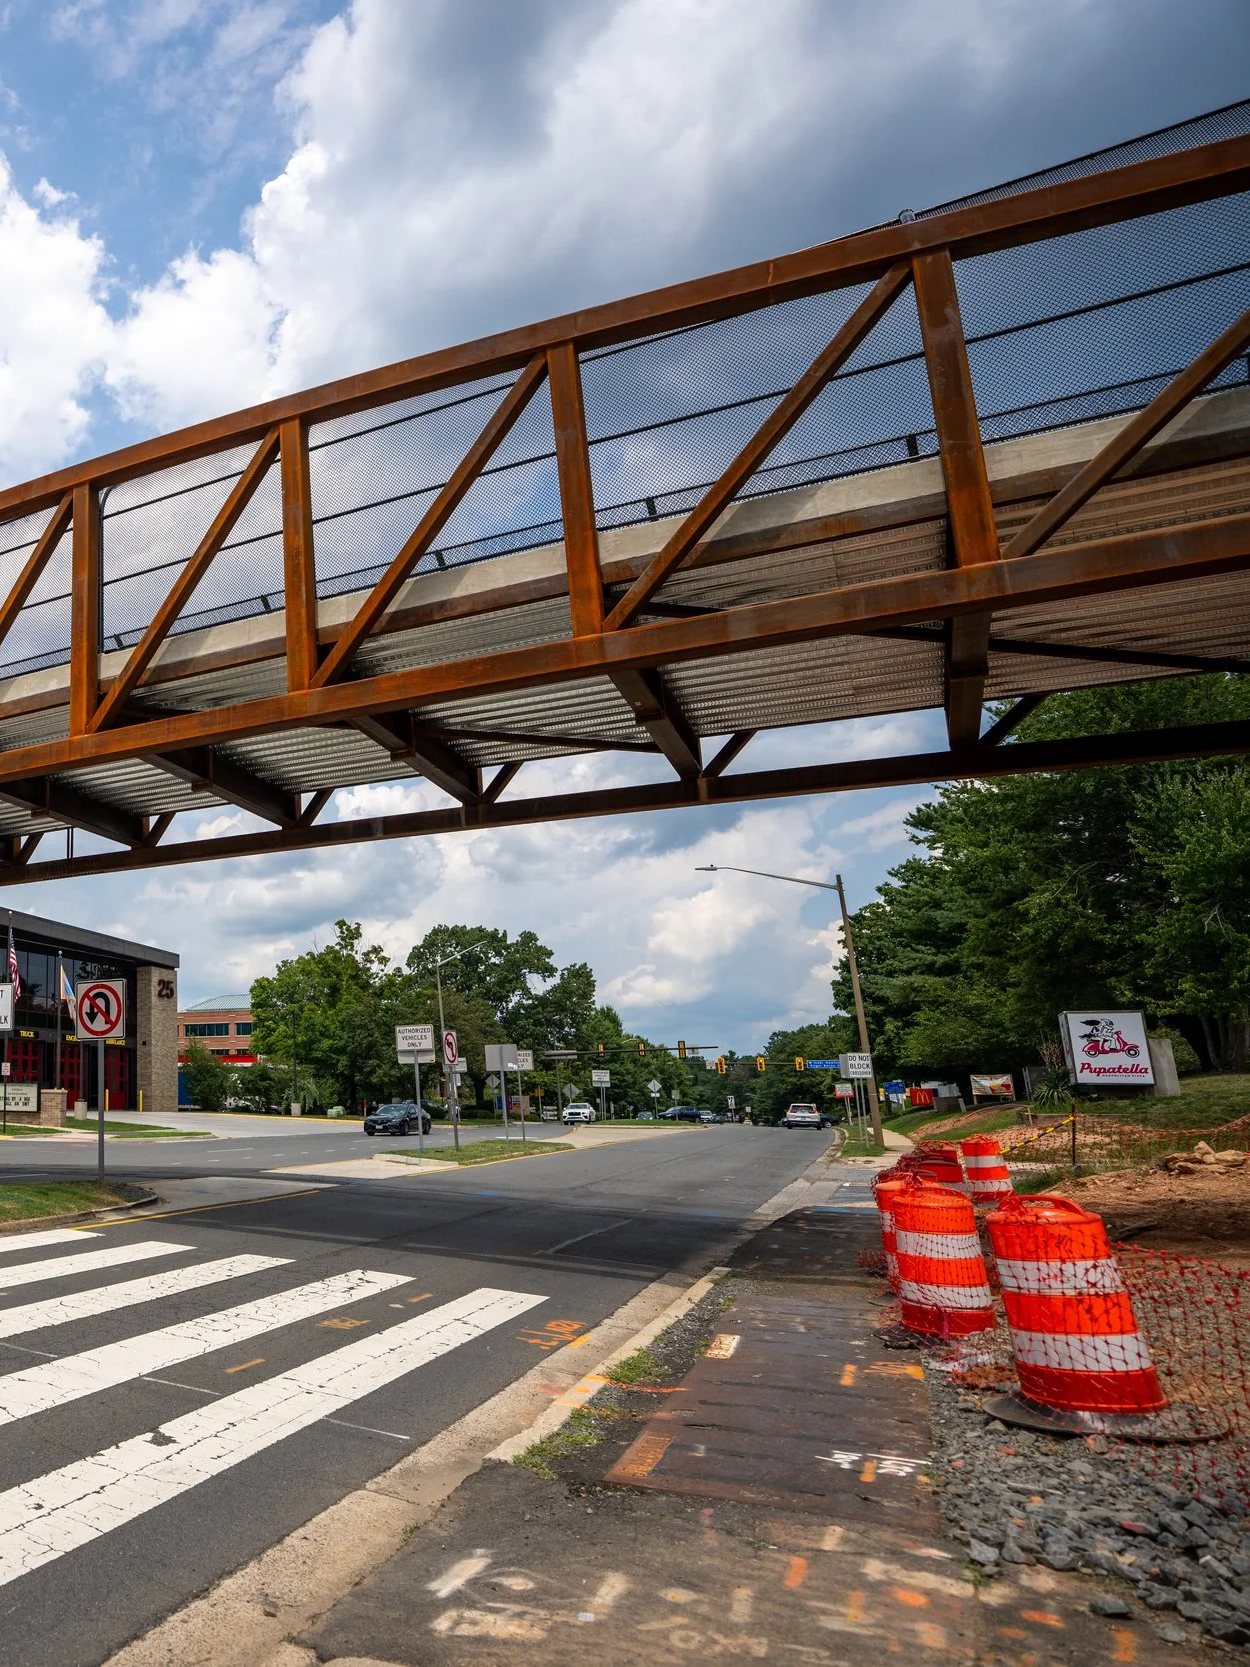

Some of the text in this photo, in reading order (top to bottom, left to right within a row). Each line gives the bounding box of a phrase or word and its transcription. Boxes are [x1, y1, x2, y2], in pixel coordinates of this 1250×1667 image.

[157, 979, 174, 999] 25
[19, 1030, 34, 1038] TRUCK
[1079, 1062, 1149, 1076] Pupatella
